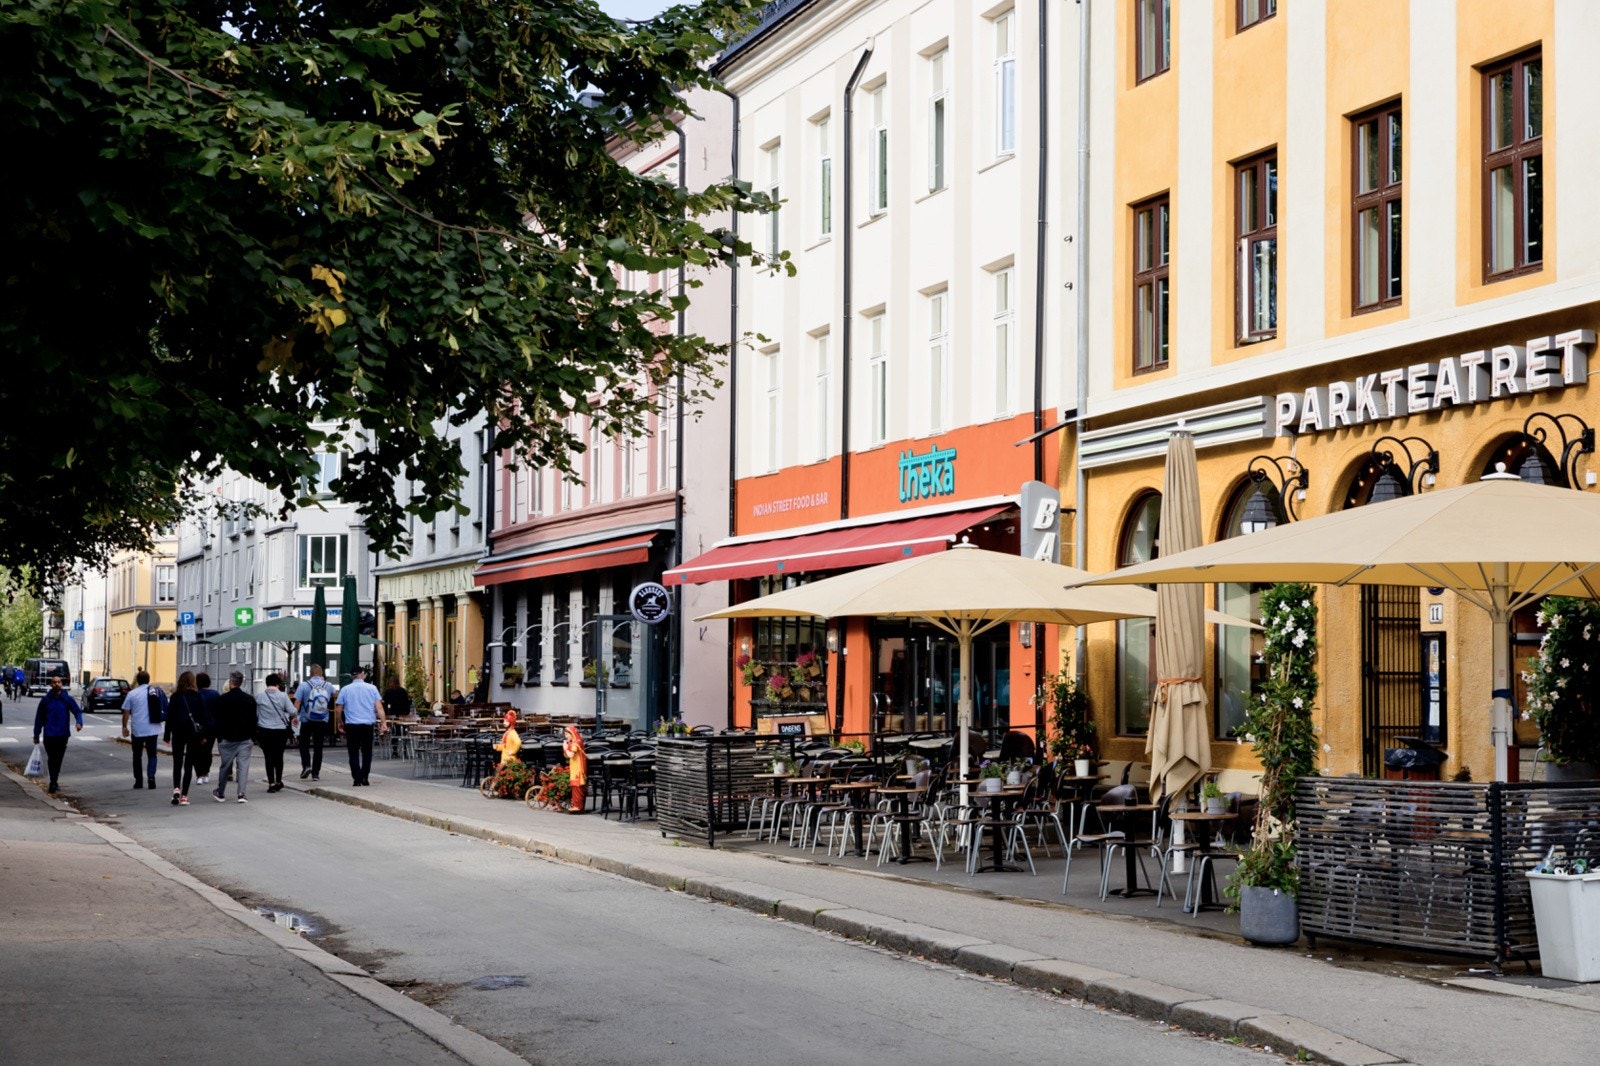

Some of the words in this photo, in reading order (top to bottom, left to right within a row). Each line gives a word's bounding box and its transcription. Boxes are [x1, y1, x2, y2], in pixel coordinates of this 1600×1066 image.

[1275, 329, 1595, 438] PARKTEATRET
[898, 443, 957, 503] theka
[753, 503, 772, 517] INDIAN
[772, 498, 793, 514] STREET
[793, 495, 810, 510] FOOD
[811, 494, 816, 507] &
[815, 491, 829, 506] BAR
[389, 577, 414, 599] VILLA
[184, 613, 192, 624] P
[1432, 607, 1440, 620] 11
[781, 724, 802, 733] DAGENS
